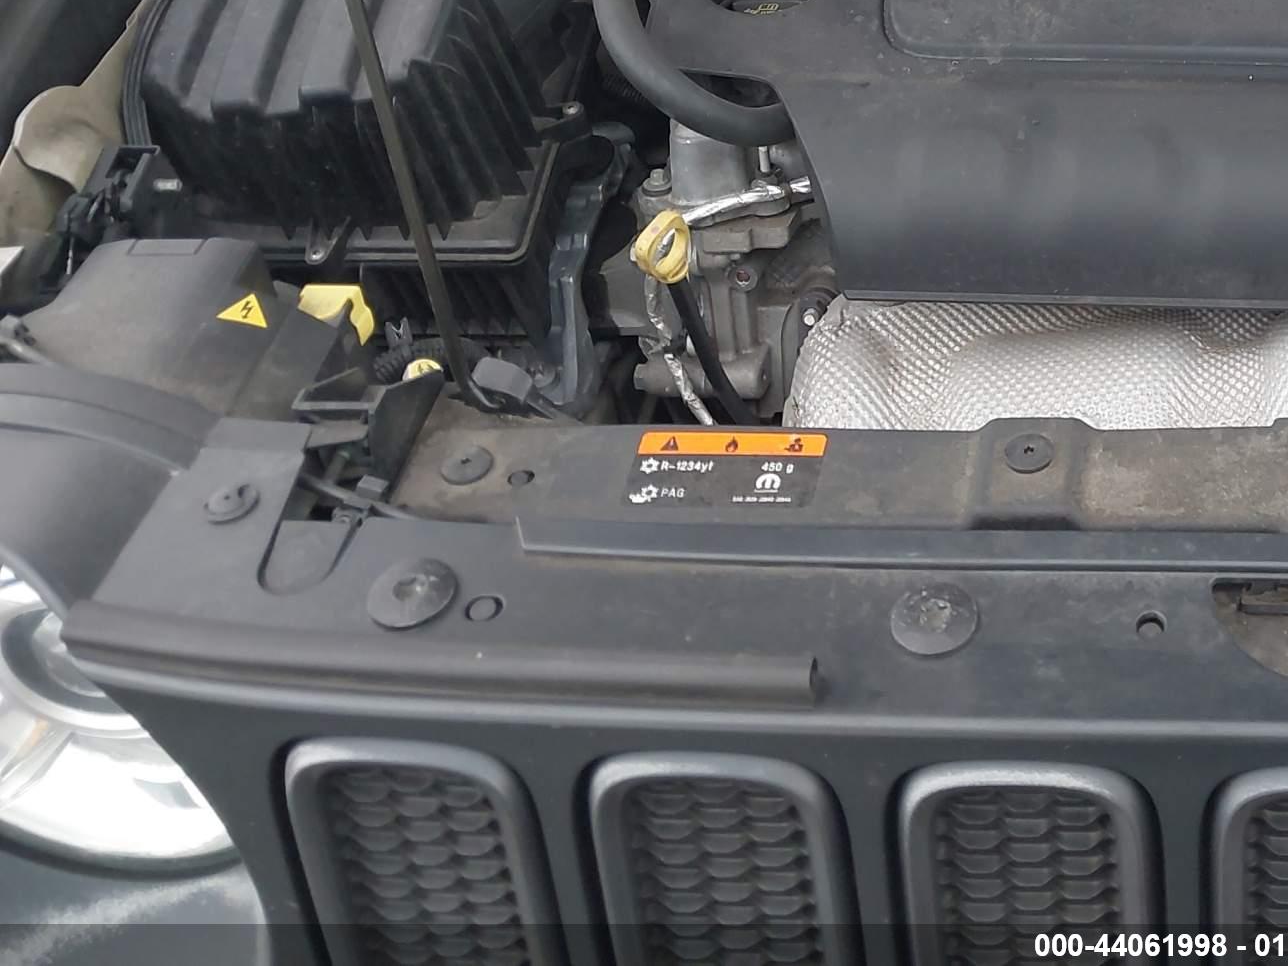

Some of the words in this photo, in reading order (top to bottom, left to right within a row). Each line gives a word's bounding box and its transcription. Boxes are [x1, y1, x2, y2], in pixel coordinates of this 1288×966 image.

[660, 460, 714, 473] R-1234yf
[761, 462, 783, 472] 450
[786, 463, 795, 474] g
[660, 487, 686, 498] PAG
